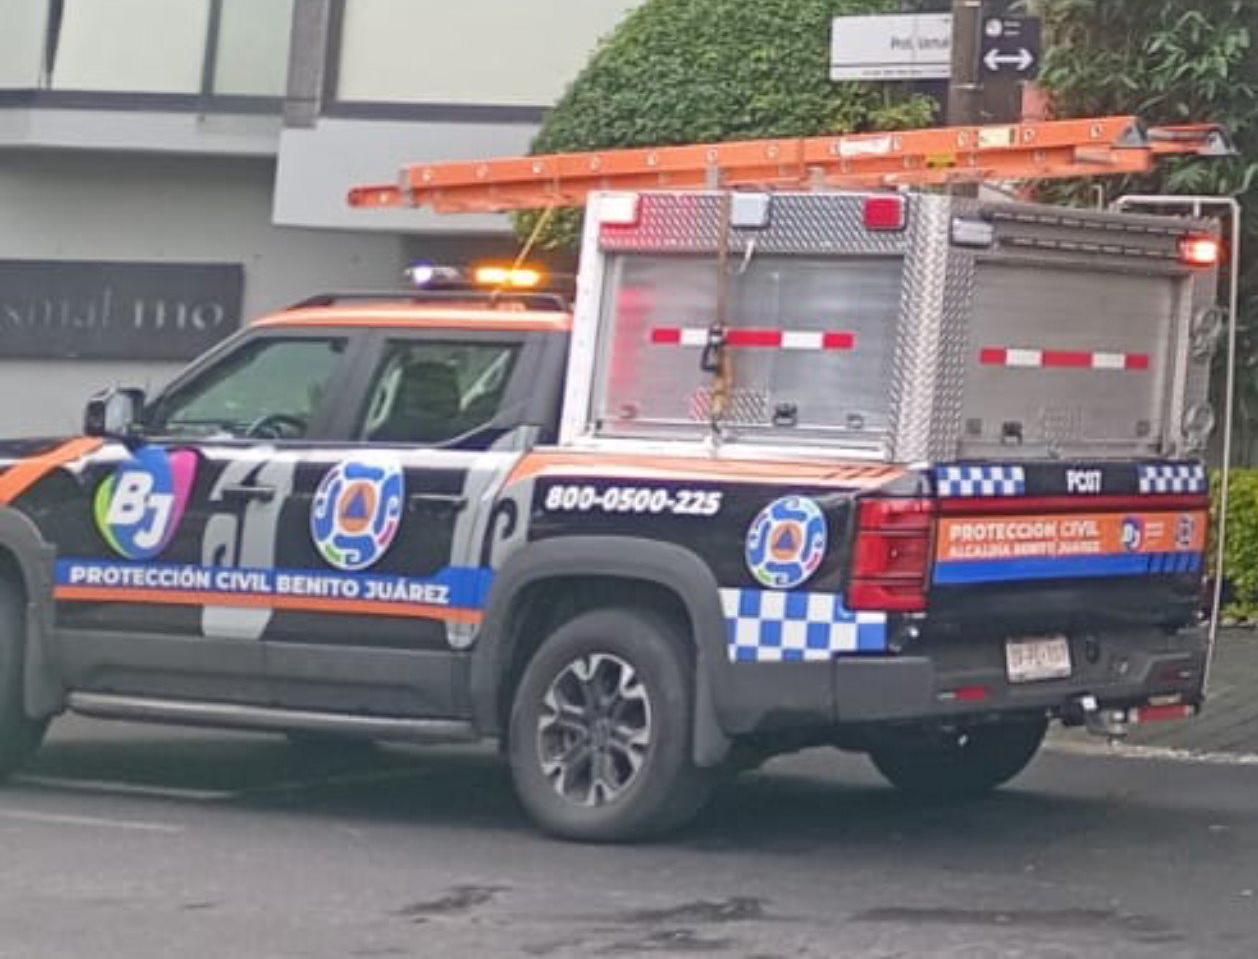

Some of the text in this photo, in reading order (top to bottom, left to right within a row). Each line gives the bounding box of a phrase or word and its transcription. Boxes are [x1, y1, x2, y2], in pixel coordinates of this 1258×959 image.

[105, 471, 175, 550] BJ
[545, 485, 723, 516] 800-0500-225
[1060, 519, 1100, 539] CIVIL
[70, 565, 449, 604] PROTECCIÓN CIVIL BENITO JUÁREZ
